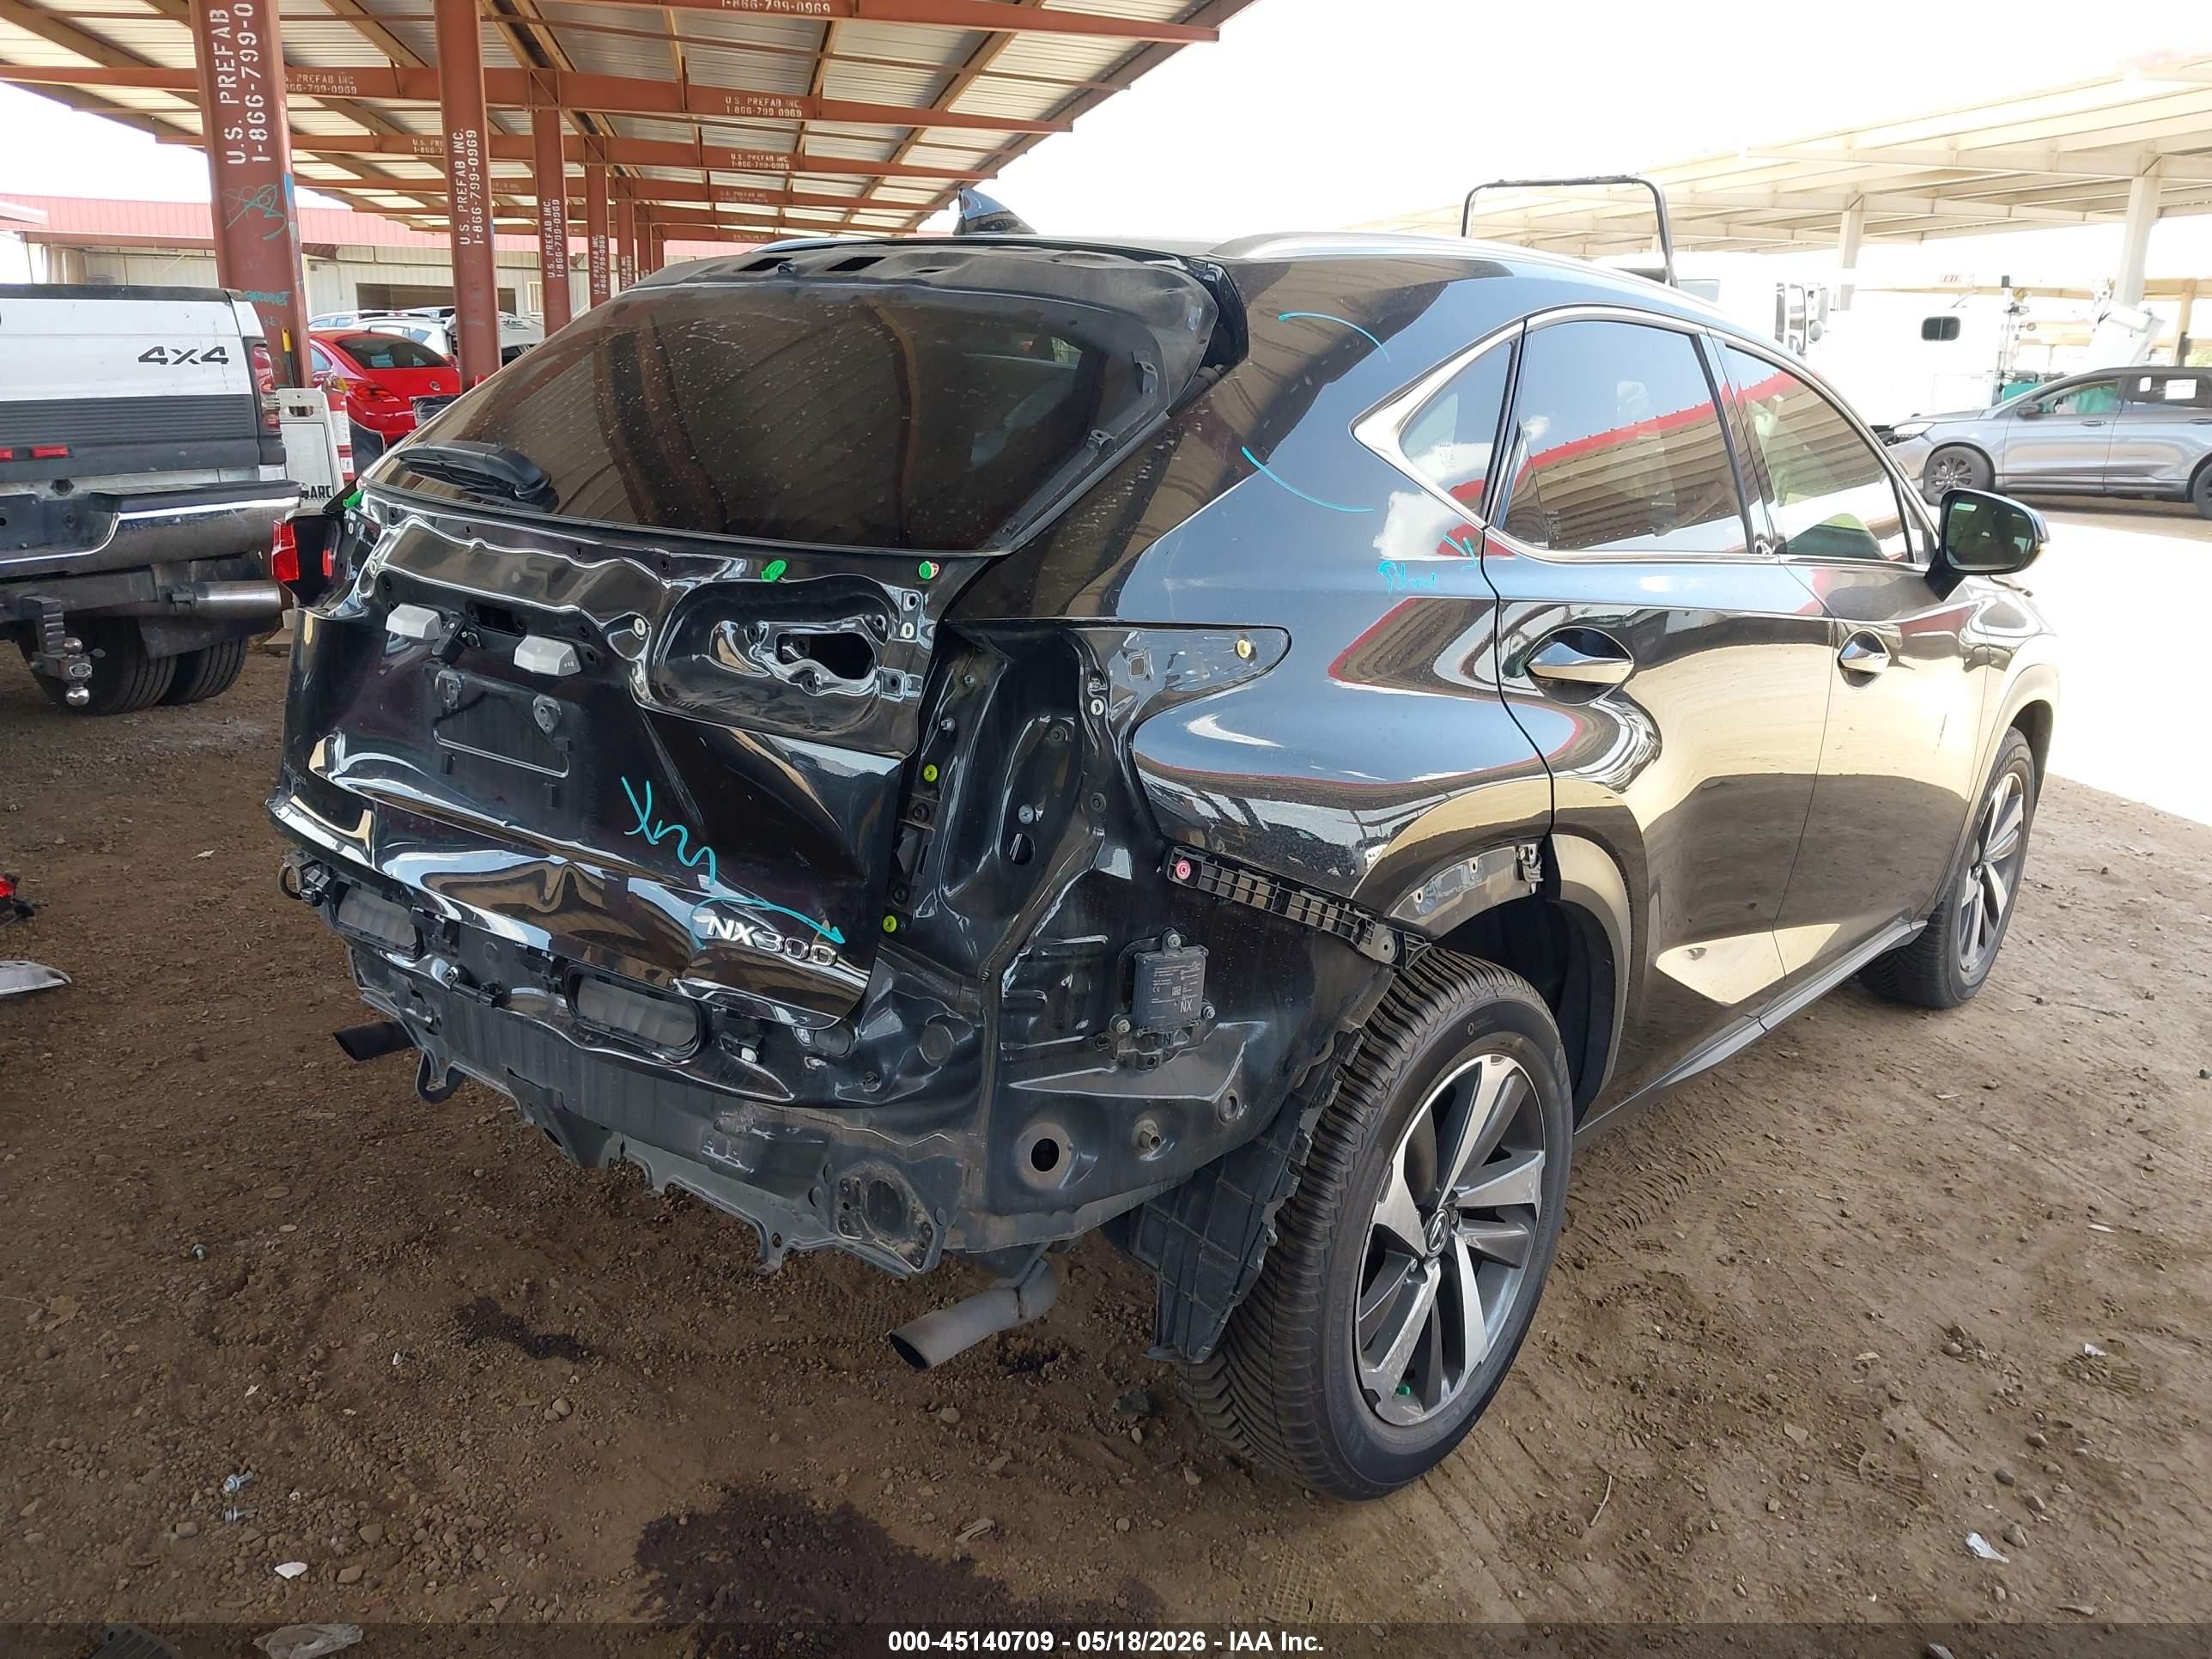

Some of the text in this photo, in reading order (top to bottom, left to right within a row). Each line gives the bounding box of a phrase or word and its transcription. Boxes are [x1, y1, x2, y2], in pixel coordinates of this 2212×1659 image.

[209, 9, 246, 164] U.S. PREFAB
[234, 3, 271, 162] 1-866-799-0
[296, 74, 334, 84] PREFAB
[747, 97, 781, 107] PREFAB
[453, 128, 471, 245] U.S. PREFAB INC.
[466, 130, 484, 244] 1-866-799-0969
[543, 198, 551, 216] INC.
[544, 221, 554, 256] PREFAB
[552, 199, 564, 277] 1-866-799-0969
[1180, 999, 1193, 1013] NX
